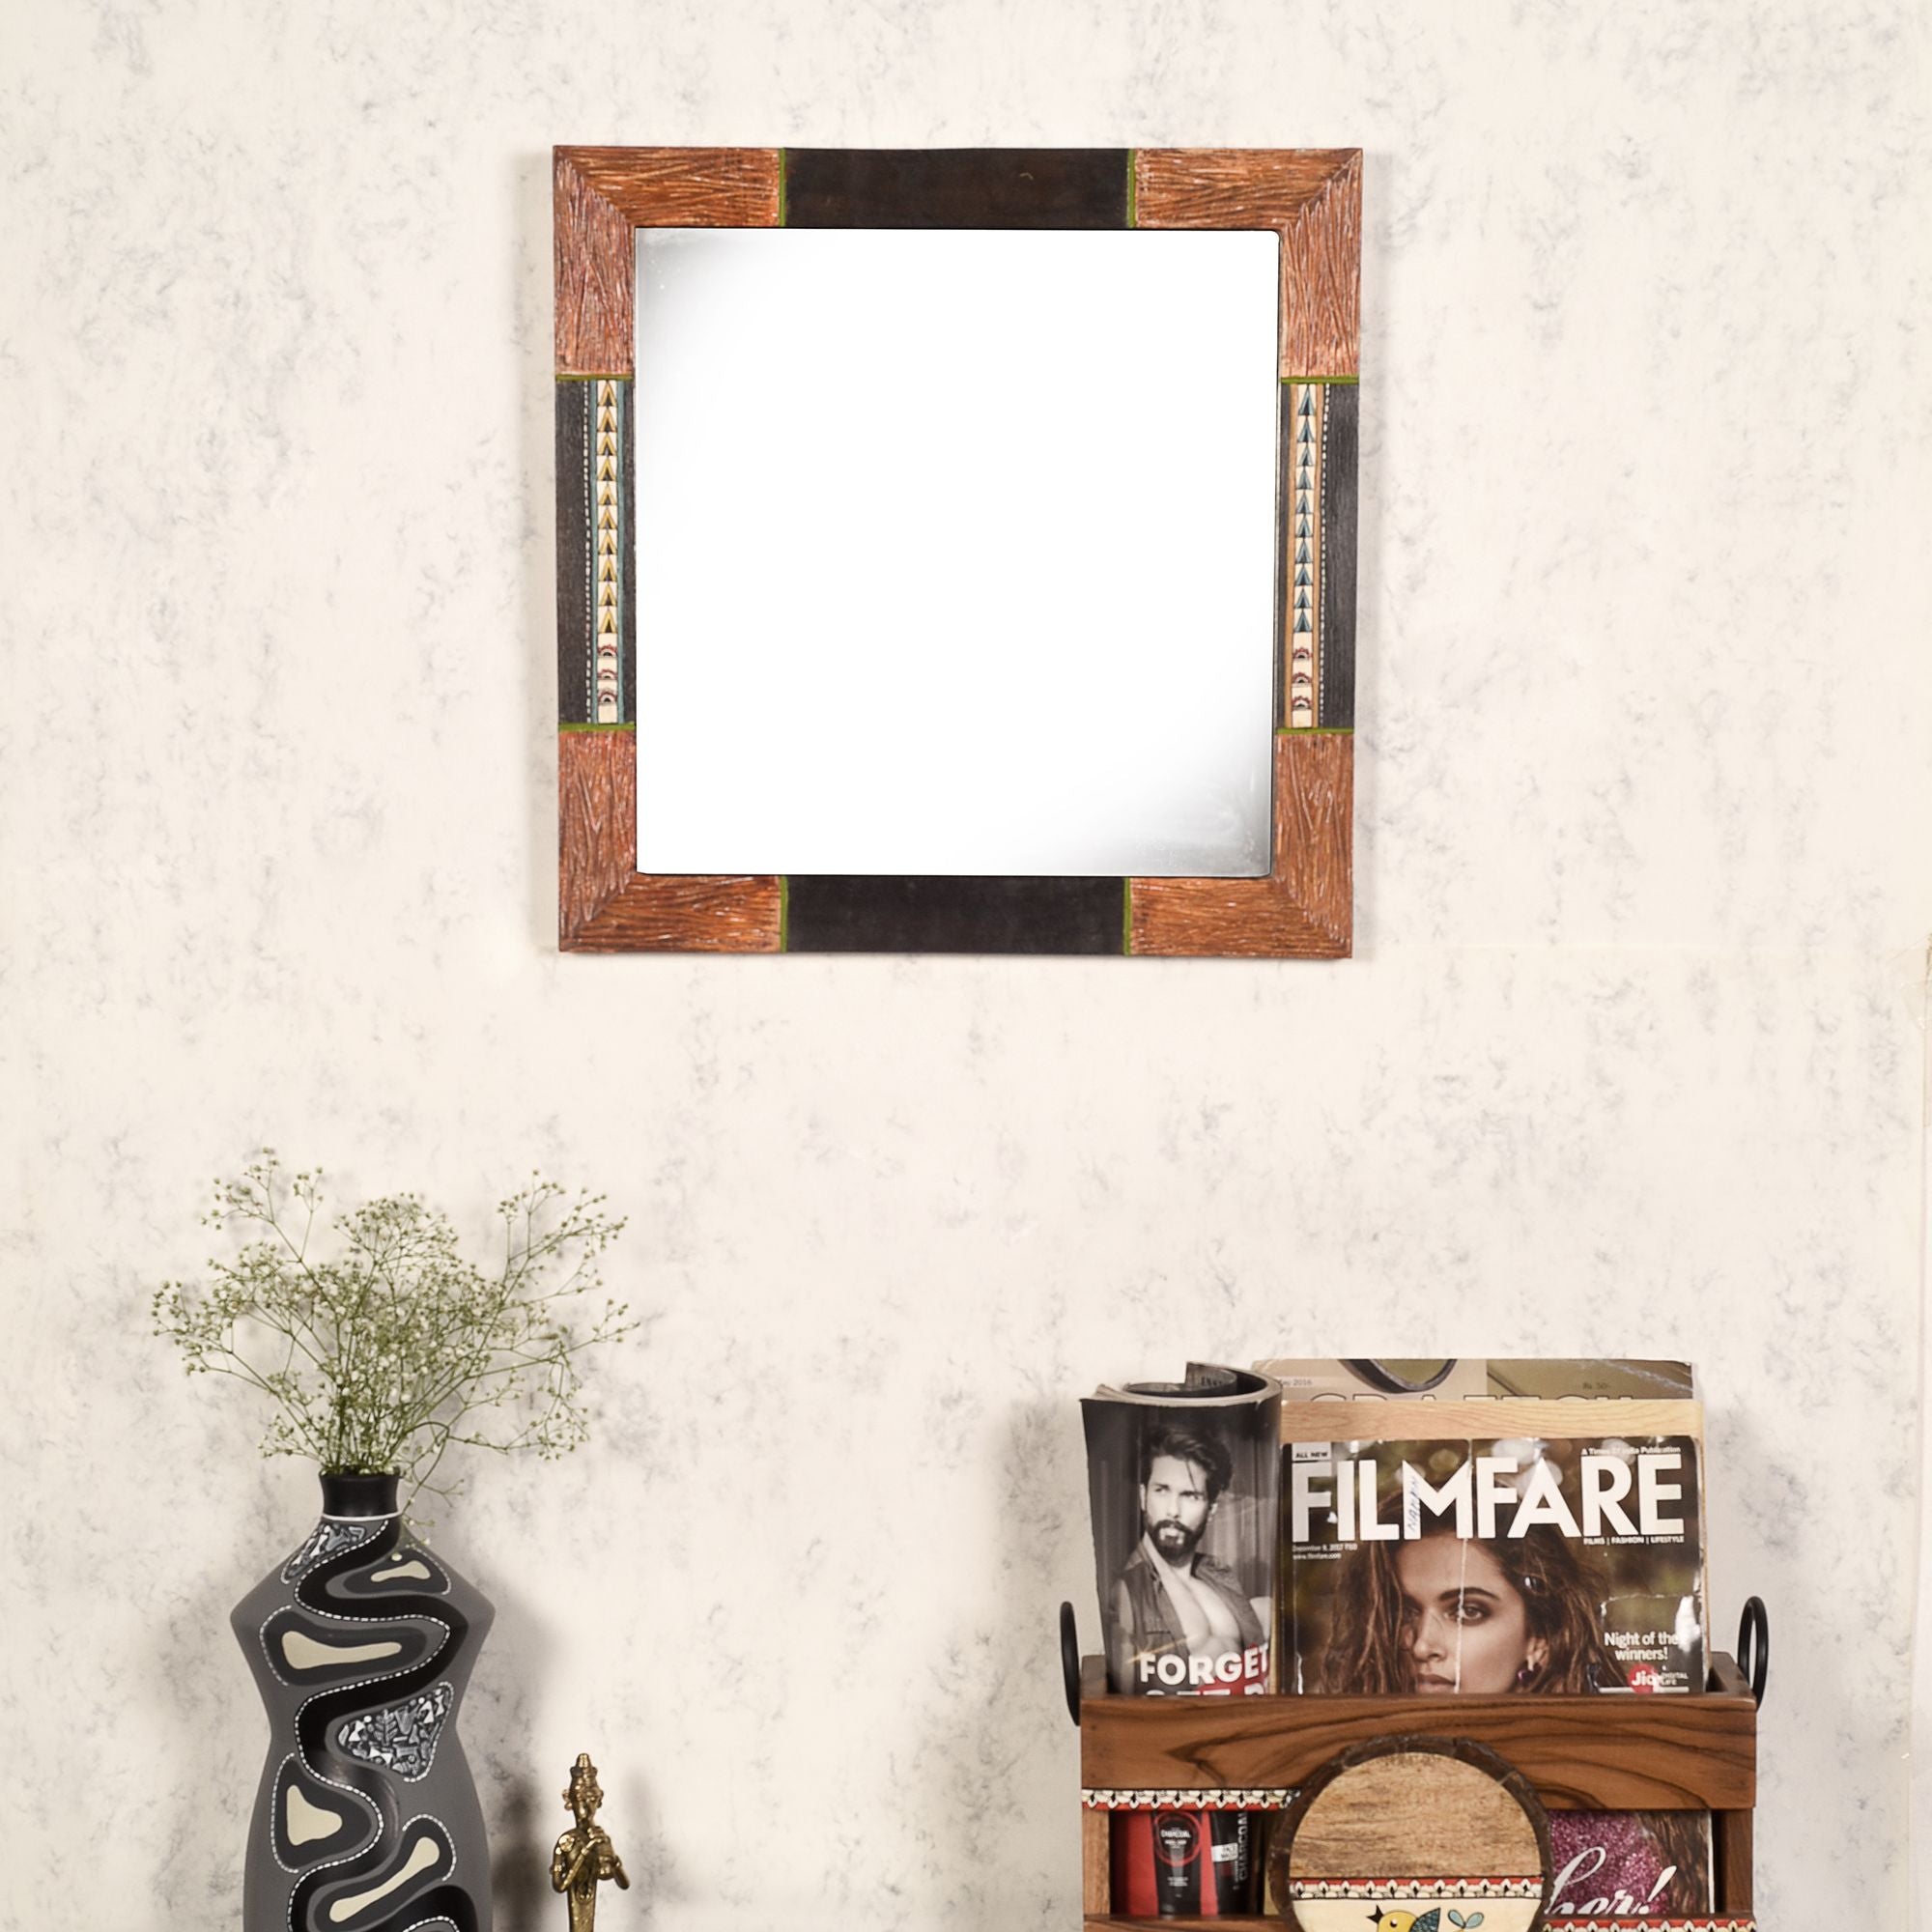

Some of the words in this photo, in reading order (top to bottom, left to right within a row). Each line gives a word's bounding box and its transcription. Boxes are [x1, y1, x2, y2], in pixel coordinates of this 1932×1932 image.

[1292, 1454, 1685, 1543] FILMFARE
[1582, 1537, 1605, 1546] FILMS
[1610, 1536, 1645, 1545] FASHION
[1650, 1535, 1685, 1544] LIFESTYLE
[1605, 1632, 1640, 1648] Night
[1642, 1631, 1657, 1645] of
[1658, 1632, 1679, 1645] the
[1614, 1646, 1668, 1661] winners!
[1140, 1642, 1268, 1685] FORGET
[1631, 1670, 1658, 1686] Jio
